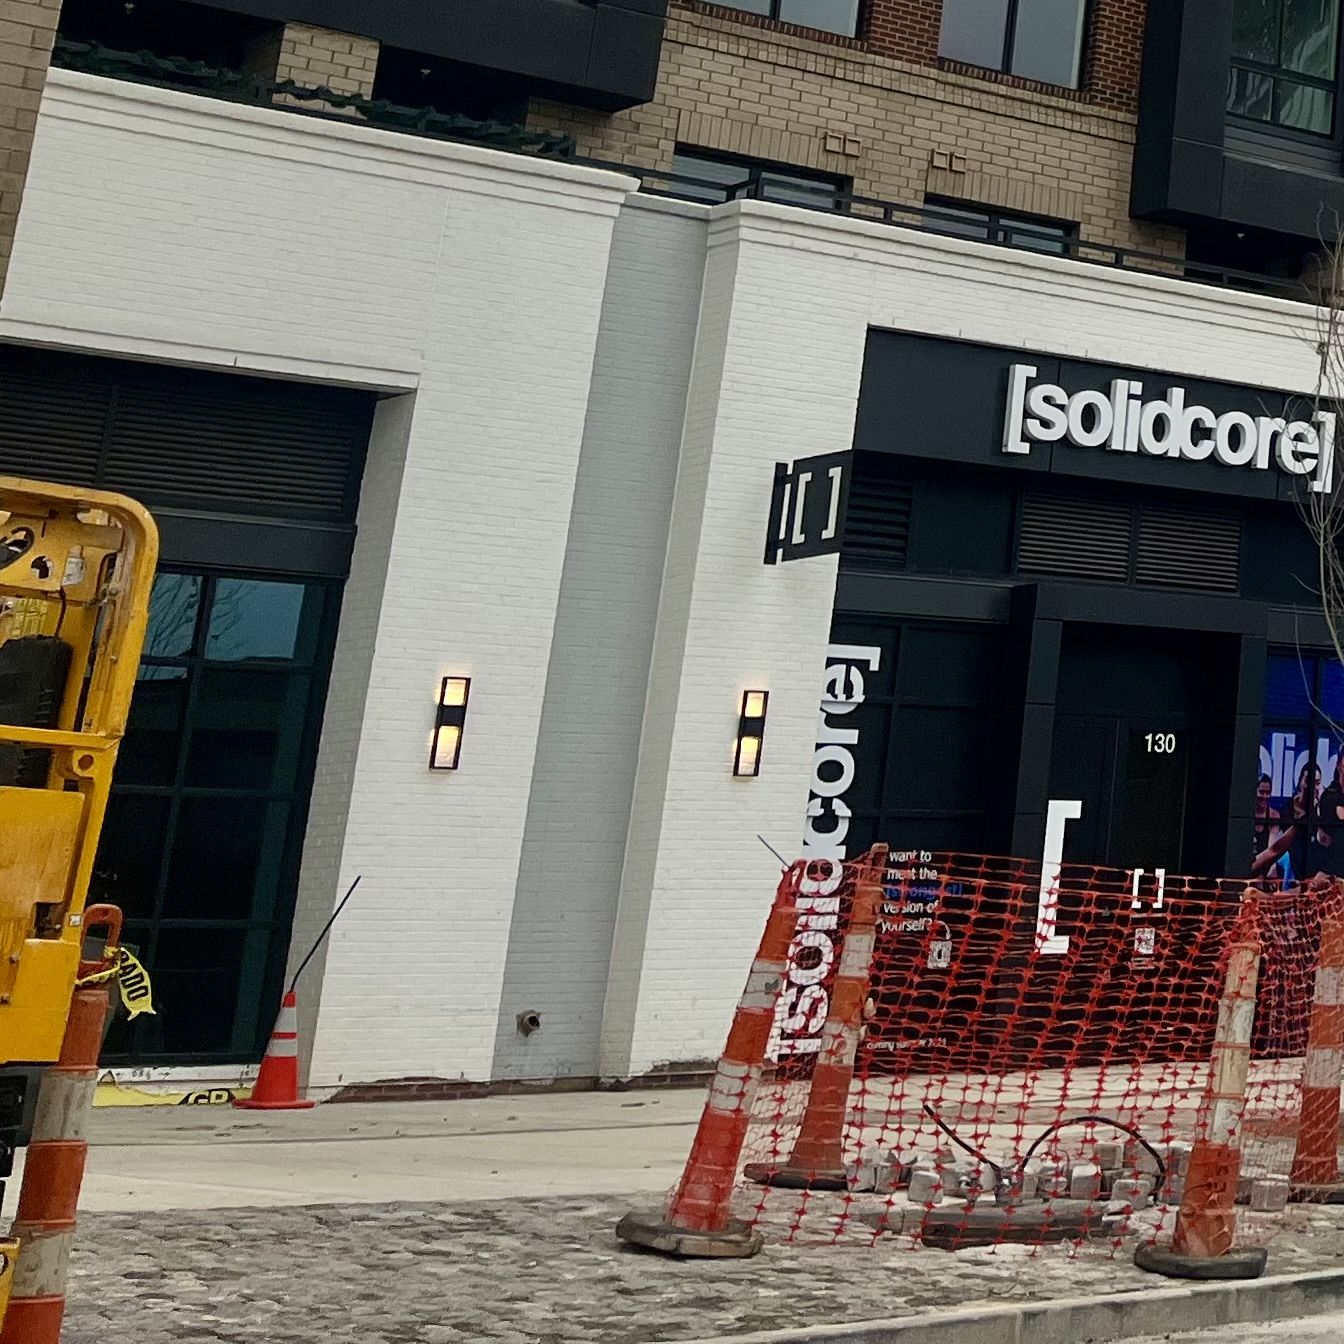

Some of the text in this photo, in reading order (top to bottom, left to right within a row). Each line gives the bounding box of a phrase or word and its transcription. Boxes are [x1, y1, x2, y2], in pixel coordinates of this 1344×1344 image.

[1002, 363, 1336, 494] [solidcore]
[1144, 733, 1176, 754] 130
[889, 850, 932, 863] want to
[887, 867, 938, 880] met the
[884, 901, 924, 914] vesion
